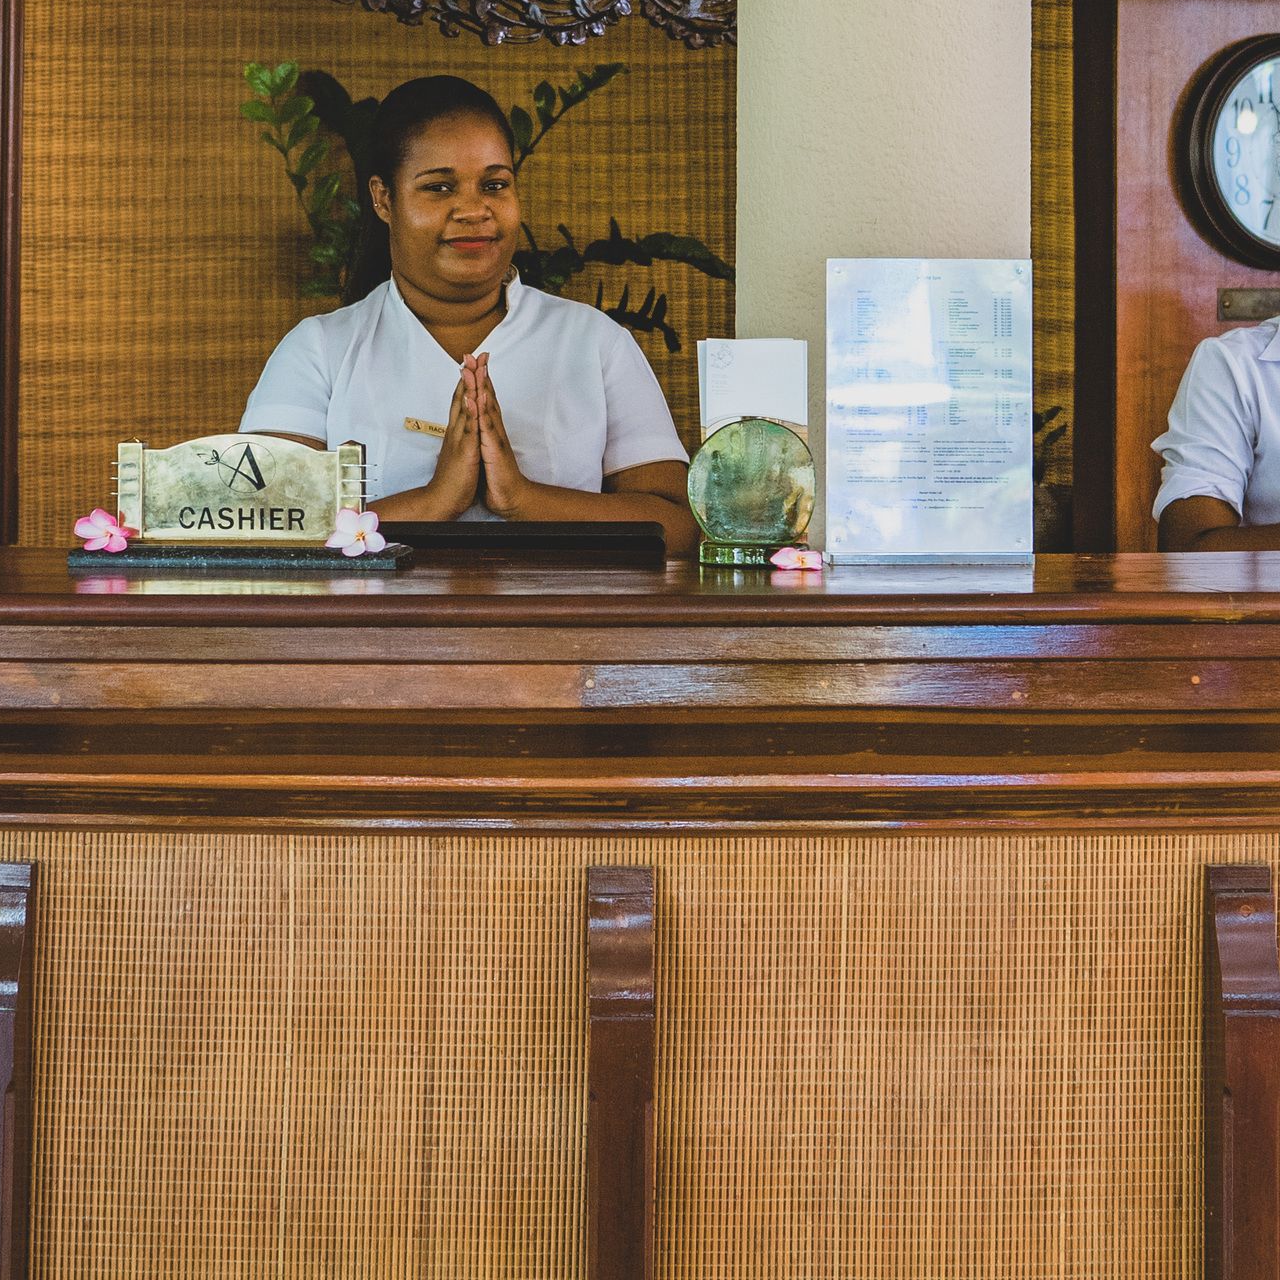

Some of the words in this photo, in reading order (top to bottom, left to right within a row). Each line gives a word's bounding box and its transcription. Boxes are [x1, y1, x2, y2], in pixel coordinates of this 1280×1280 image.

[1258, 73, 1273, 105] 11
[1225, 136, 1241, 168] 9
[1234, 174, 1251, 206] 8
[1261, 199, 1275, 231] 7
[179, 506, 305, 531] CASHIER
